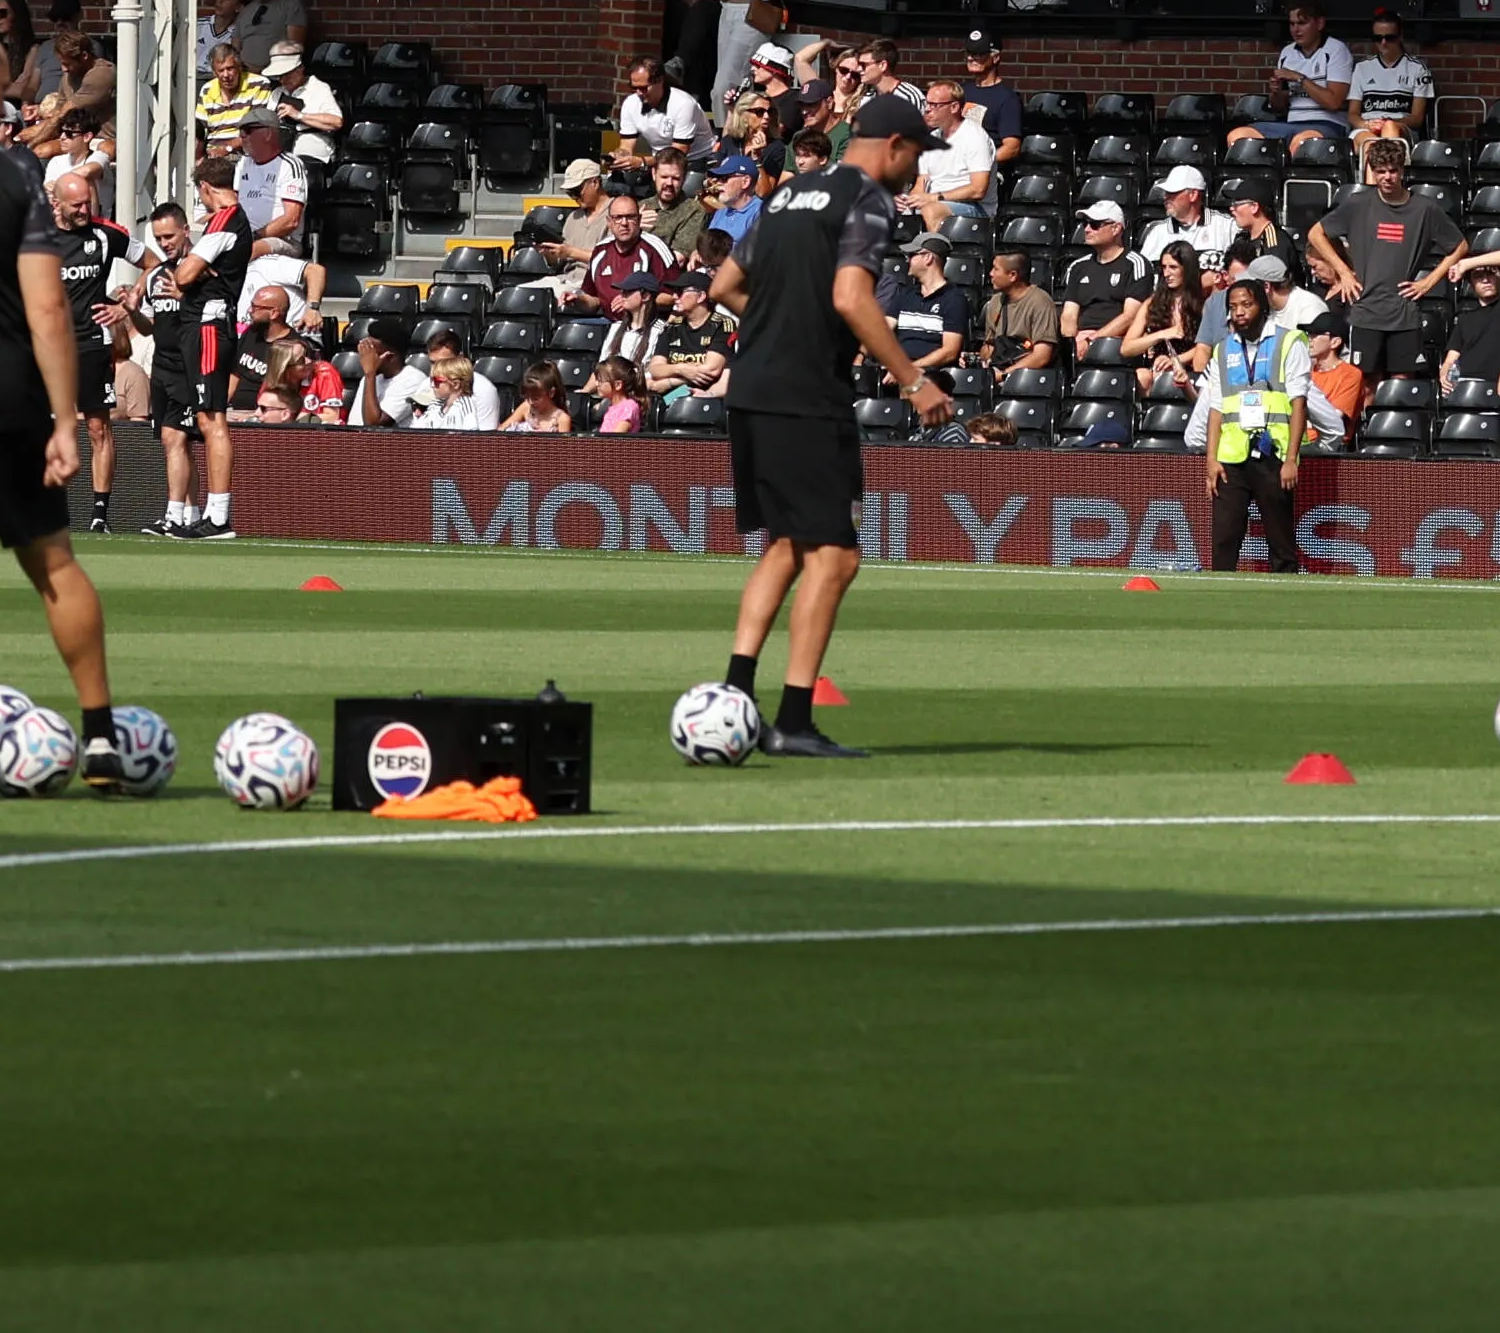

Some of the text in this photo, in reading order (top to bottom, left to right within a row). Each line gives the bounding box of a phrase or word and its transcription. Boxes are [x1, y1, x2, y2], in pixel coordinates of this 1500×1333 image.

[61, 265, 101, 280] BOTOP
[238, 352, 269, 376] HUGO
[430, 476, 1028, 565] MONLY
[1051, 495, 1375, 576] PAS
[373, 753, 426, 772] PEPSI
